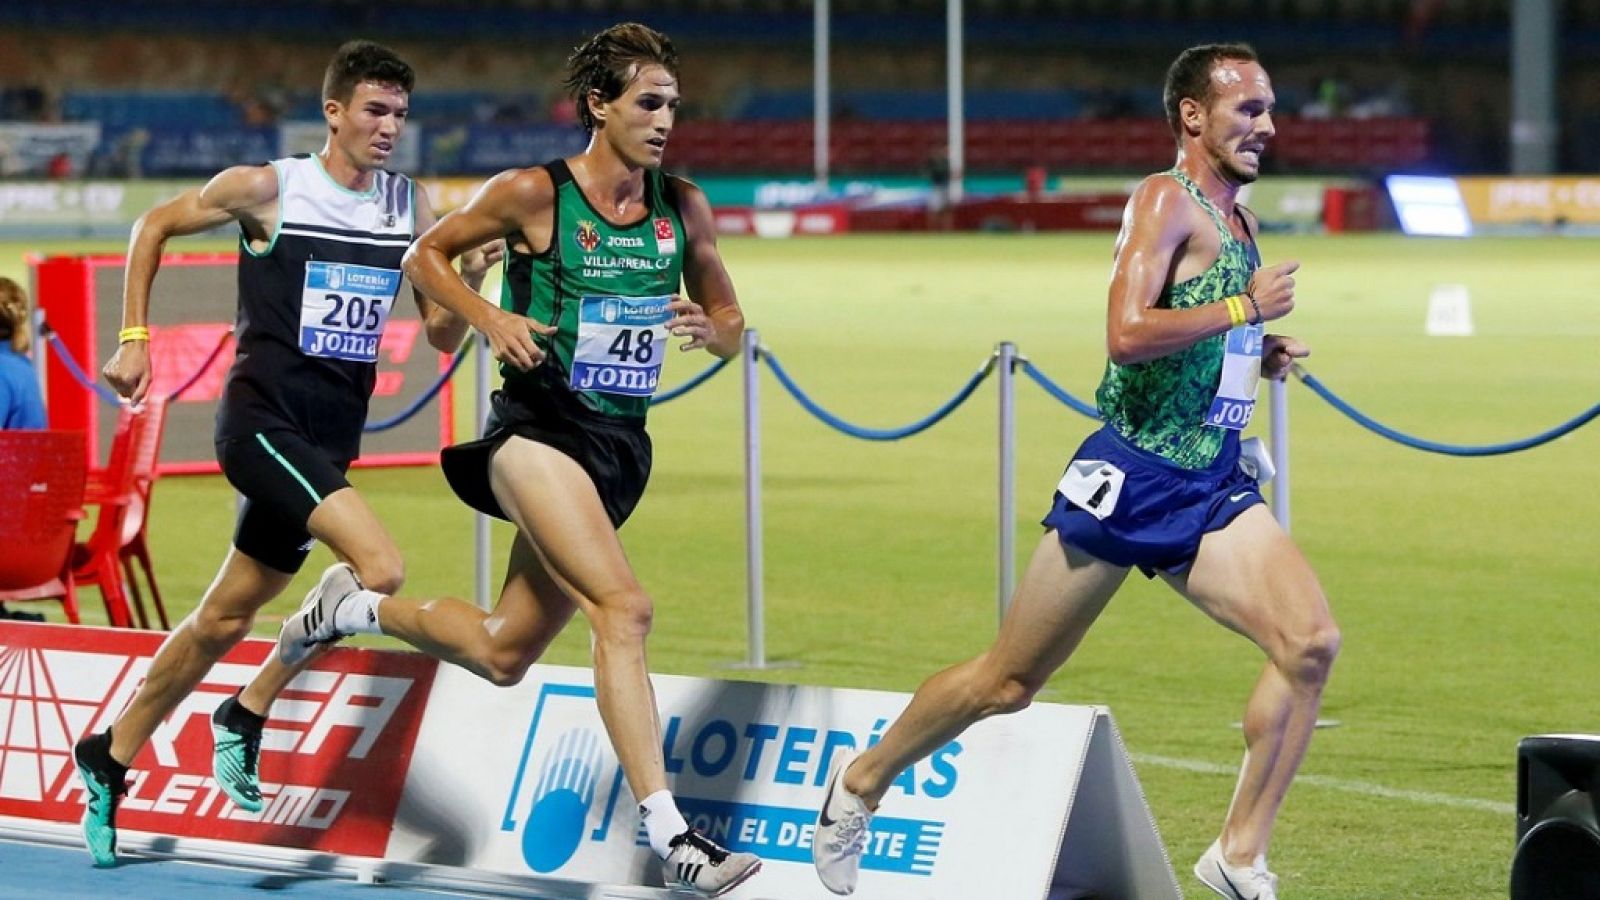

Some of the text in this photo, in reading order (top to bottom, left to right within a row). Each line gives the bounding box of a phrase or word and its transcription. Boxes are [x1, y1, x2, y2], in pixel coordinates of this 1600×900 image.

[583, 256, 653, 270] VILLARREAL
[321, 294, 382, 331] 205
[608, 329, 654, 363] 48
[738, 818, 771, 845] EL
